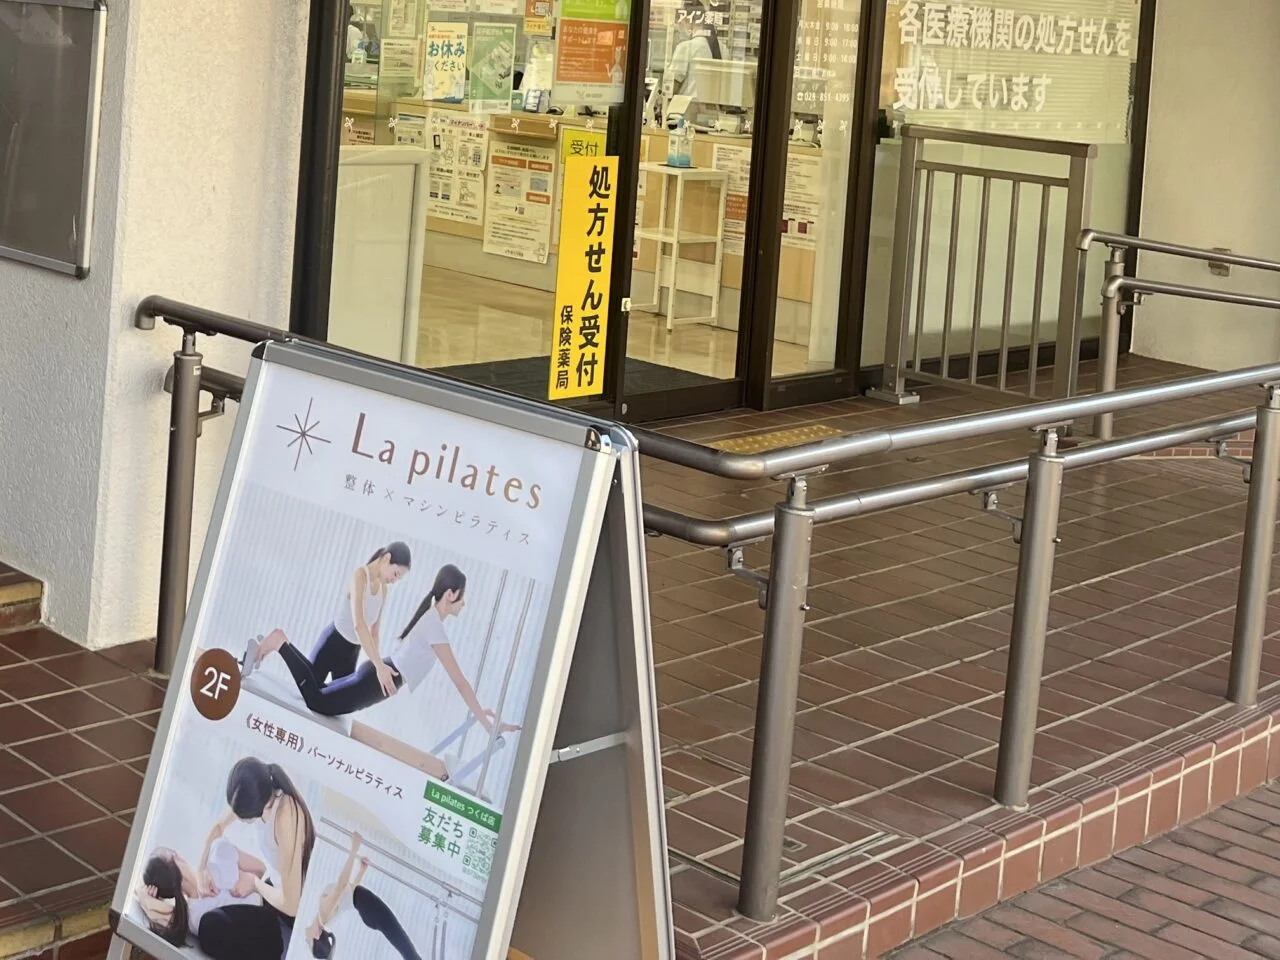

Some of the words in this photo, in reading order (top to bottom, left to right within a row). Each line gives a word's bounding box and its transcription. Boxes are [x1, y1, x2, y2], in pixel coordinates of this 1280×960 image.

[677, 9, 724, 26] アイン薬局
[427, 39, 466, 59] お休み
[434, 60, 465, 72] ください
[892, 67, 1053, 112] 受付しています
[570, 139, 600, 157] 受付
[575, 164, 611, 389] 処方せん受付
[555, 304, 574, 390] 保険薬局
[351, 411, 396, 466] La
[406, 442, 542, 510] pilates
[199, 666, 232, 701] 2F
[422, 806, 464, 839] 友だち
[431, 788, 440, 800] La
[440, 795, 466, 812] pilates
[466, 806, 497, 826] つくば店
[417, 824, 461, 859] 募集中
